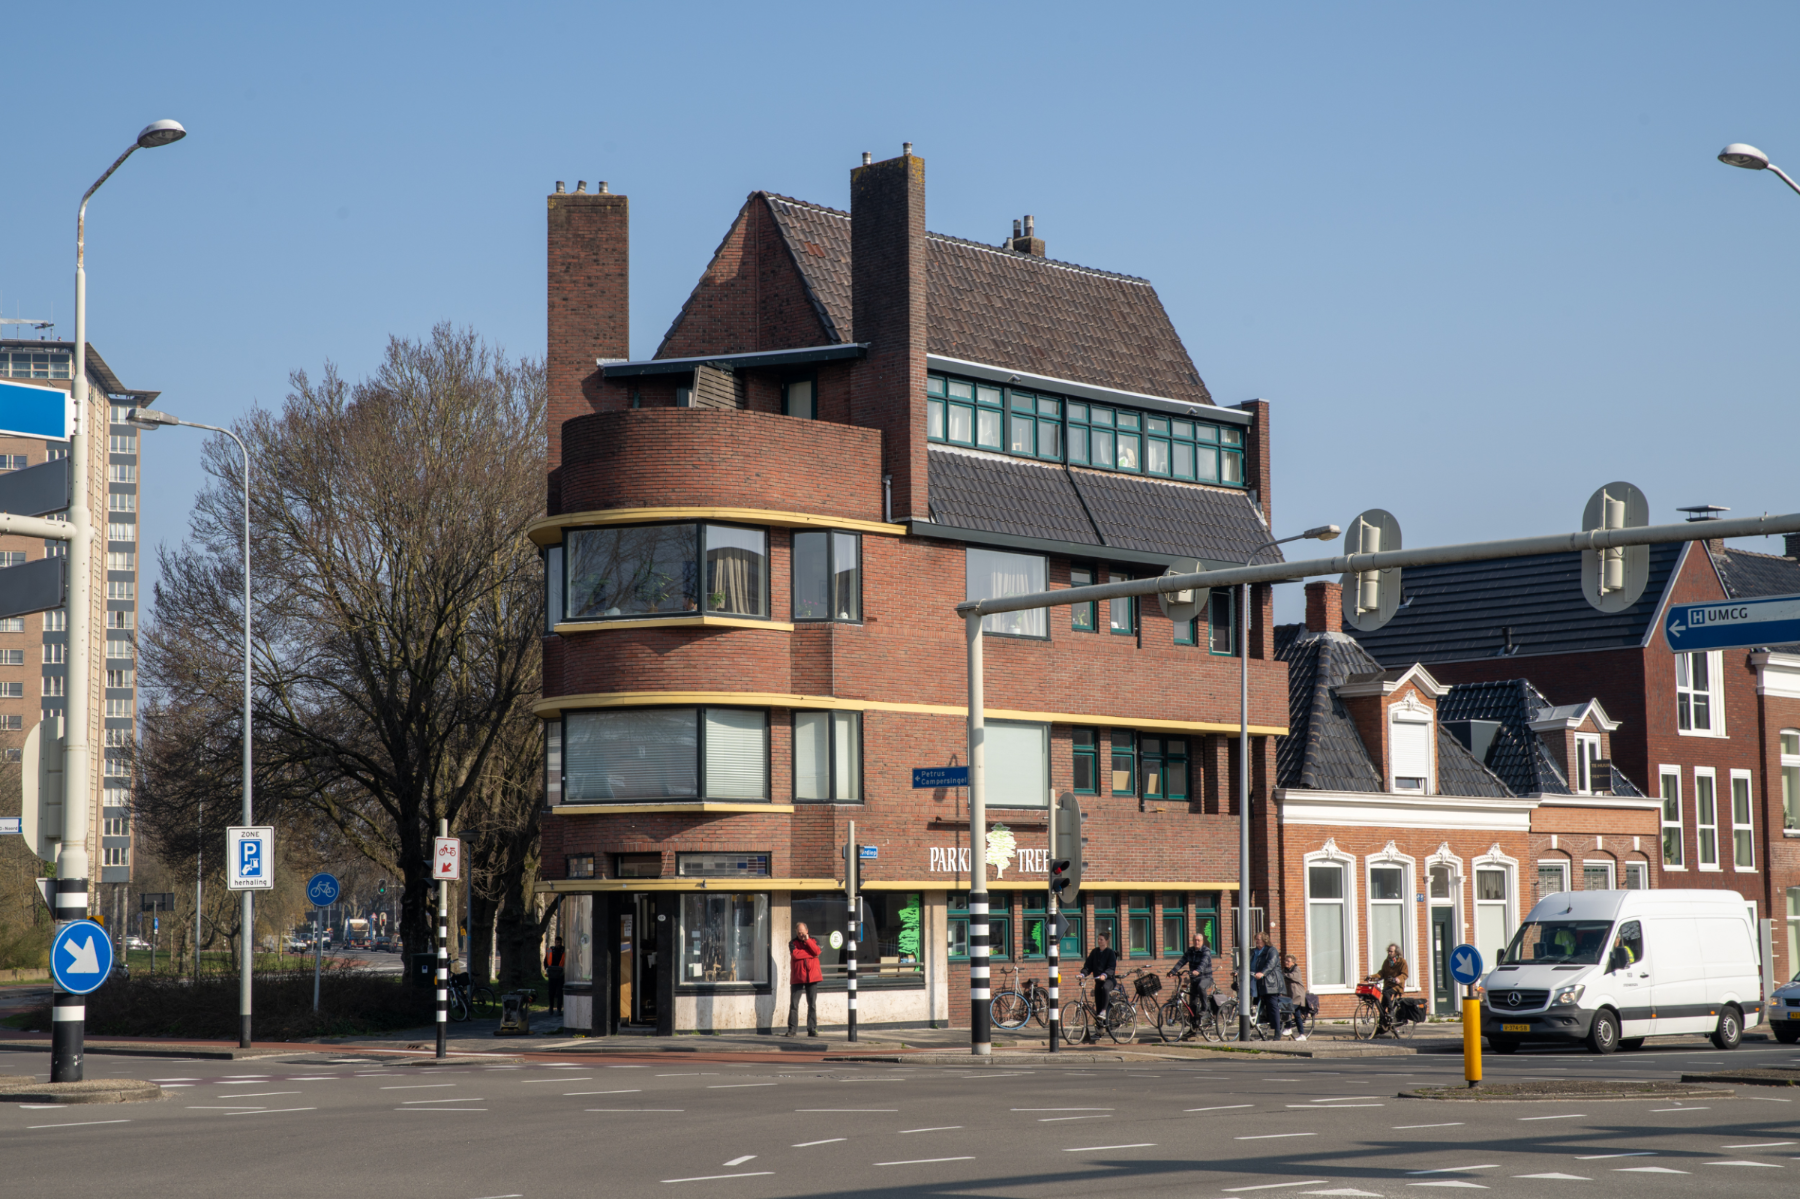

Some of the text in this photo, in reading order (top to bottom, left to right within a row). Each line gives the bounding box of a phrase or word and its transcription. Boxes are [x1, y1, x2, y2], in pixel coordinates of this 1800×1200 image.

[1708, 607, 1748, 622] UMCG
[921, 777, 967, 785] Campersingel
[244, 843, 257, 862] P
[929, 846, 972, 872] PARK
[234, 879, 267, 887] herhaling
